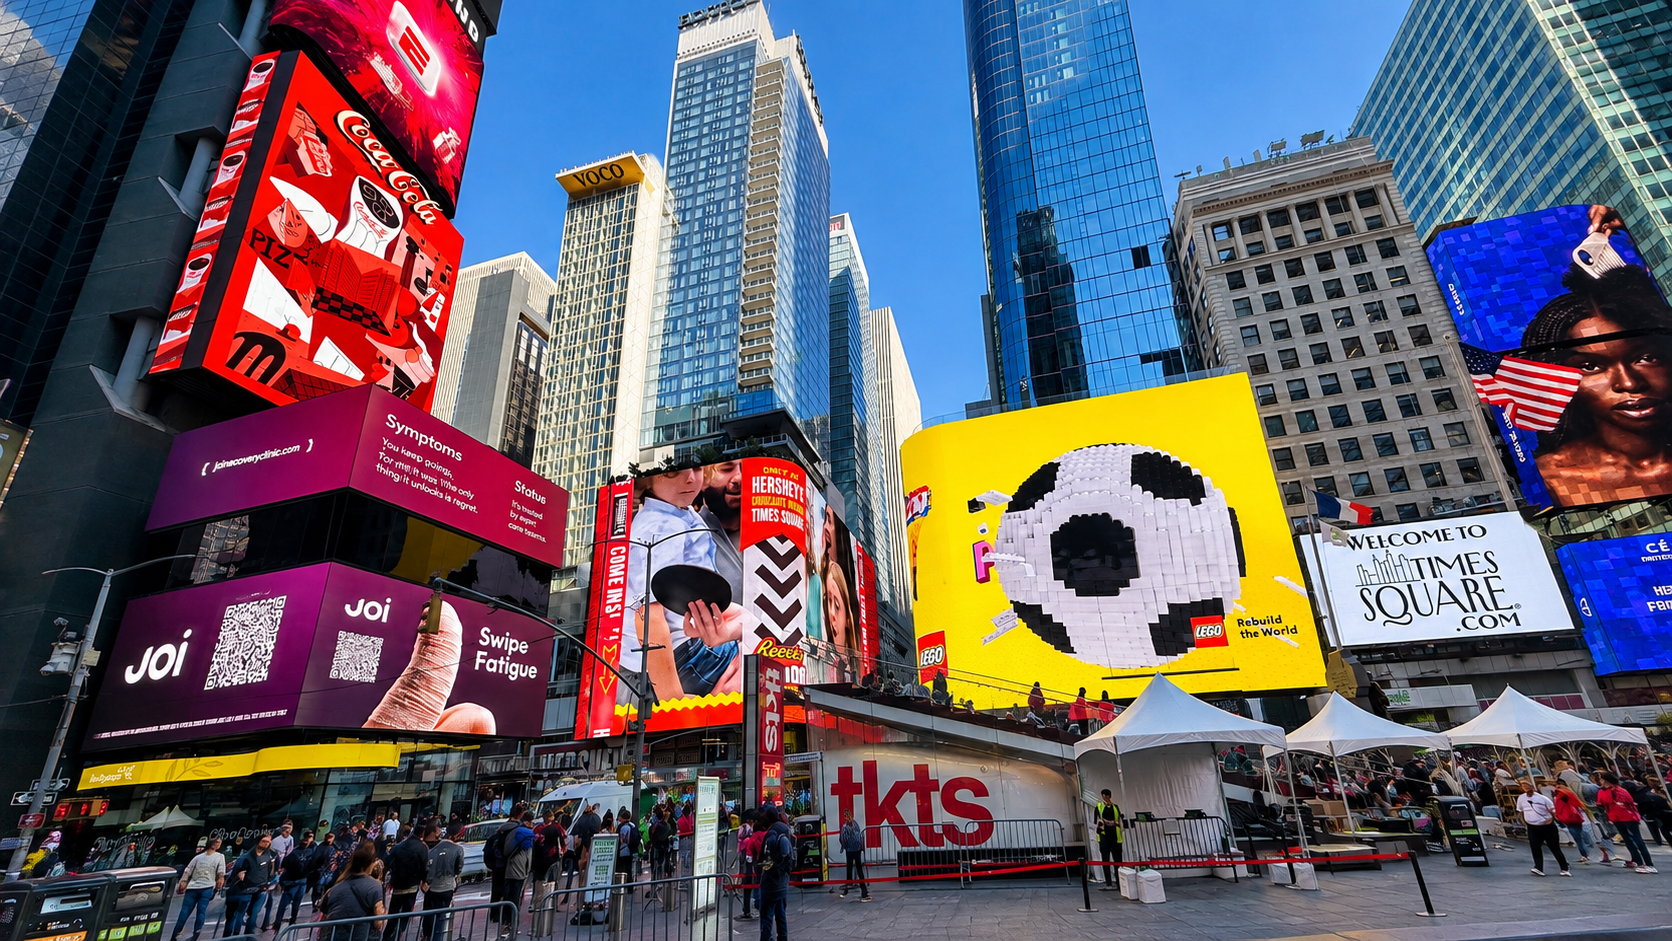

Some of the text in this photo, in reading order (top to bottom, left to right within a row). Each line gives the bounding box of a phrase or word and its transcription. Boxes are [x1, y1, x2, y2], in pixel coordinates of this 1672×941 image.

[449, 0, 479, 43] ND
[385, 413, 463, 462] Symptoms
[514, 480, 546, 505] Status
[751, 508, 780, 523] TIMES
[1347, 524, 1487, 551] WELCOME TO
[608, 545, 627, 587] COME
[1410, 550, 1499, 580] TIMES
[1195, 624, 1223, 639] LEGO
[1236, 615, 1283, 628] Rebuild
[1240, 625, 1299, 640] the World
[1456, 612, 1522, 632] .COM
[477, 626, 530, 655] Swipe
[473, 651, 539, 681] Fatigue
[919, 645, 944, 667] LEGO
[829, 759, 995, 849] tkts
